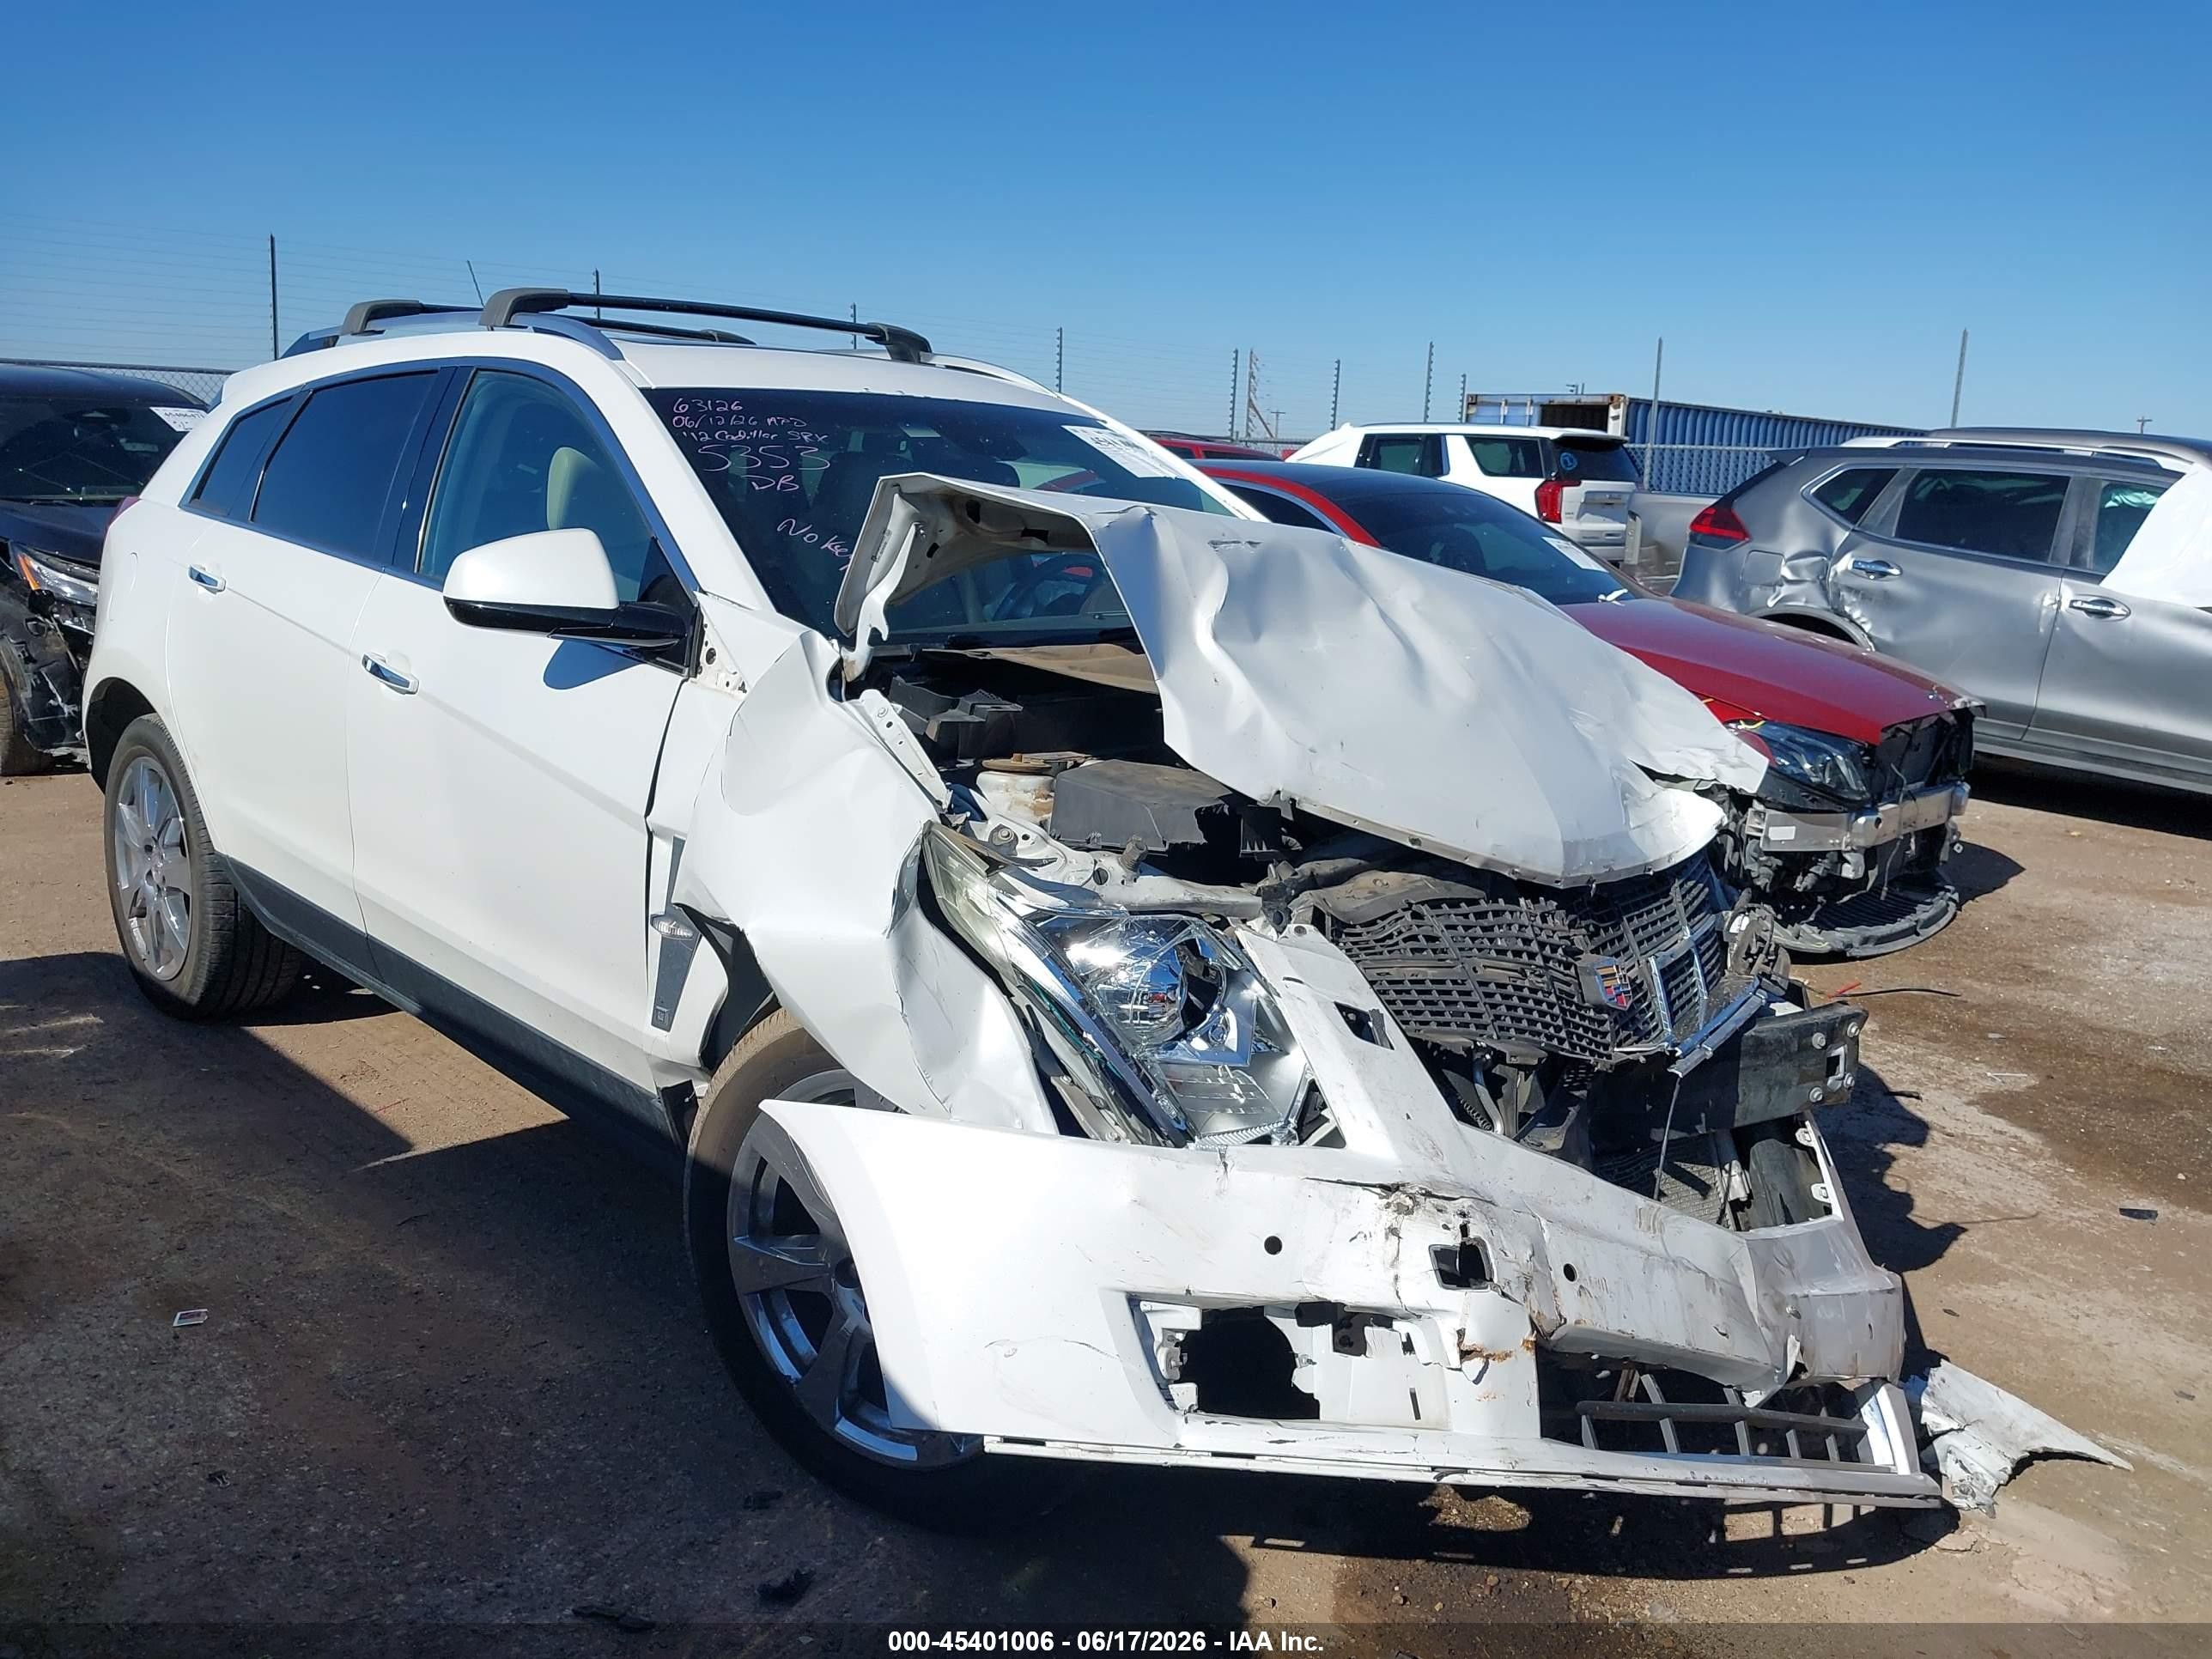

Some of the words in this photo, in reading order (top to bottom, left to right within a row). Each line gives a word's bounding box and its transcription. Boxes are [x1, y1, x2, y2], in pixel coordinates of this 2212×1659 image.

[672, 398, 744, 413] 63126
[672, 414, 757, 428] 06/12/26
[787, 430, 830, 443] SRX
[697, 444, 831, 471] 5353
[741, 474, 799, 491] DB
[776, 518, 818, 544] No
[820, 535, 852, 571] Ke
